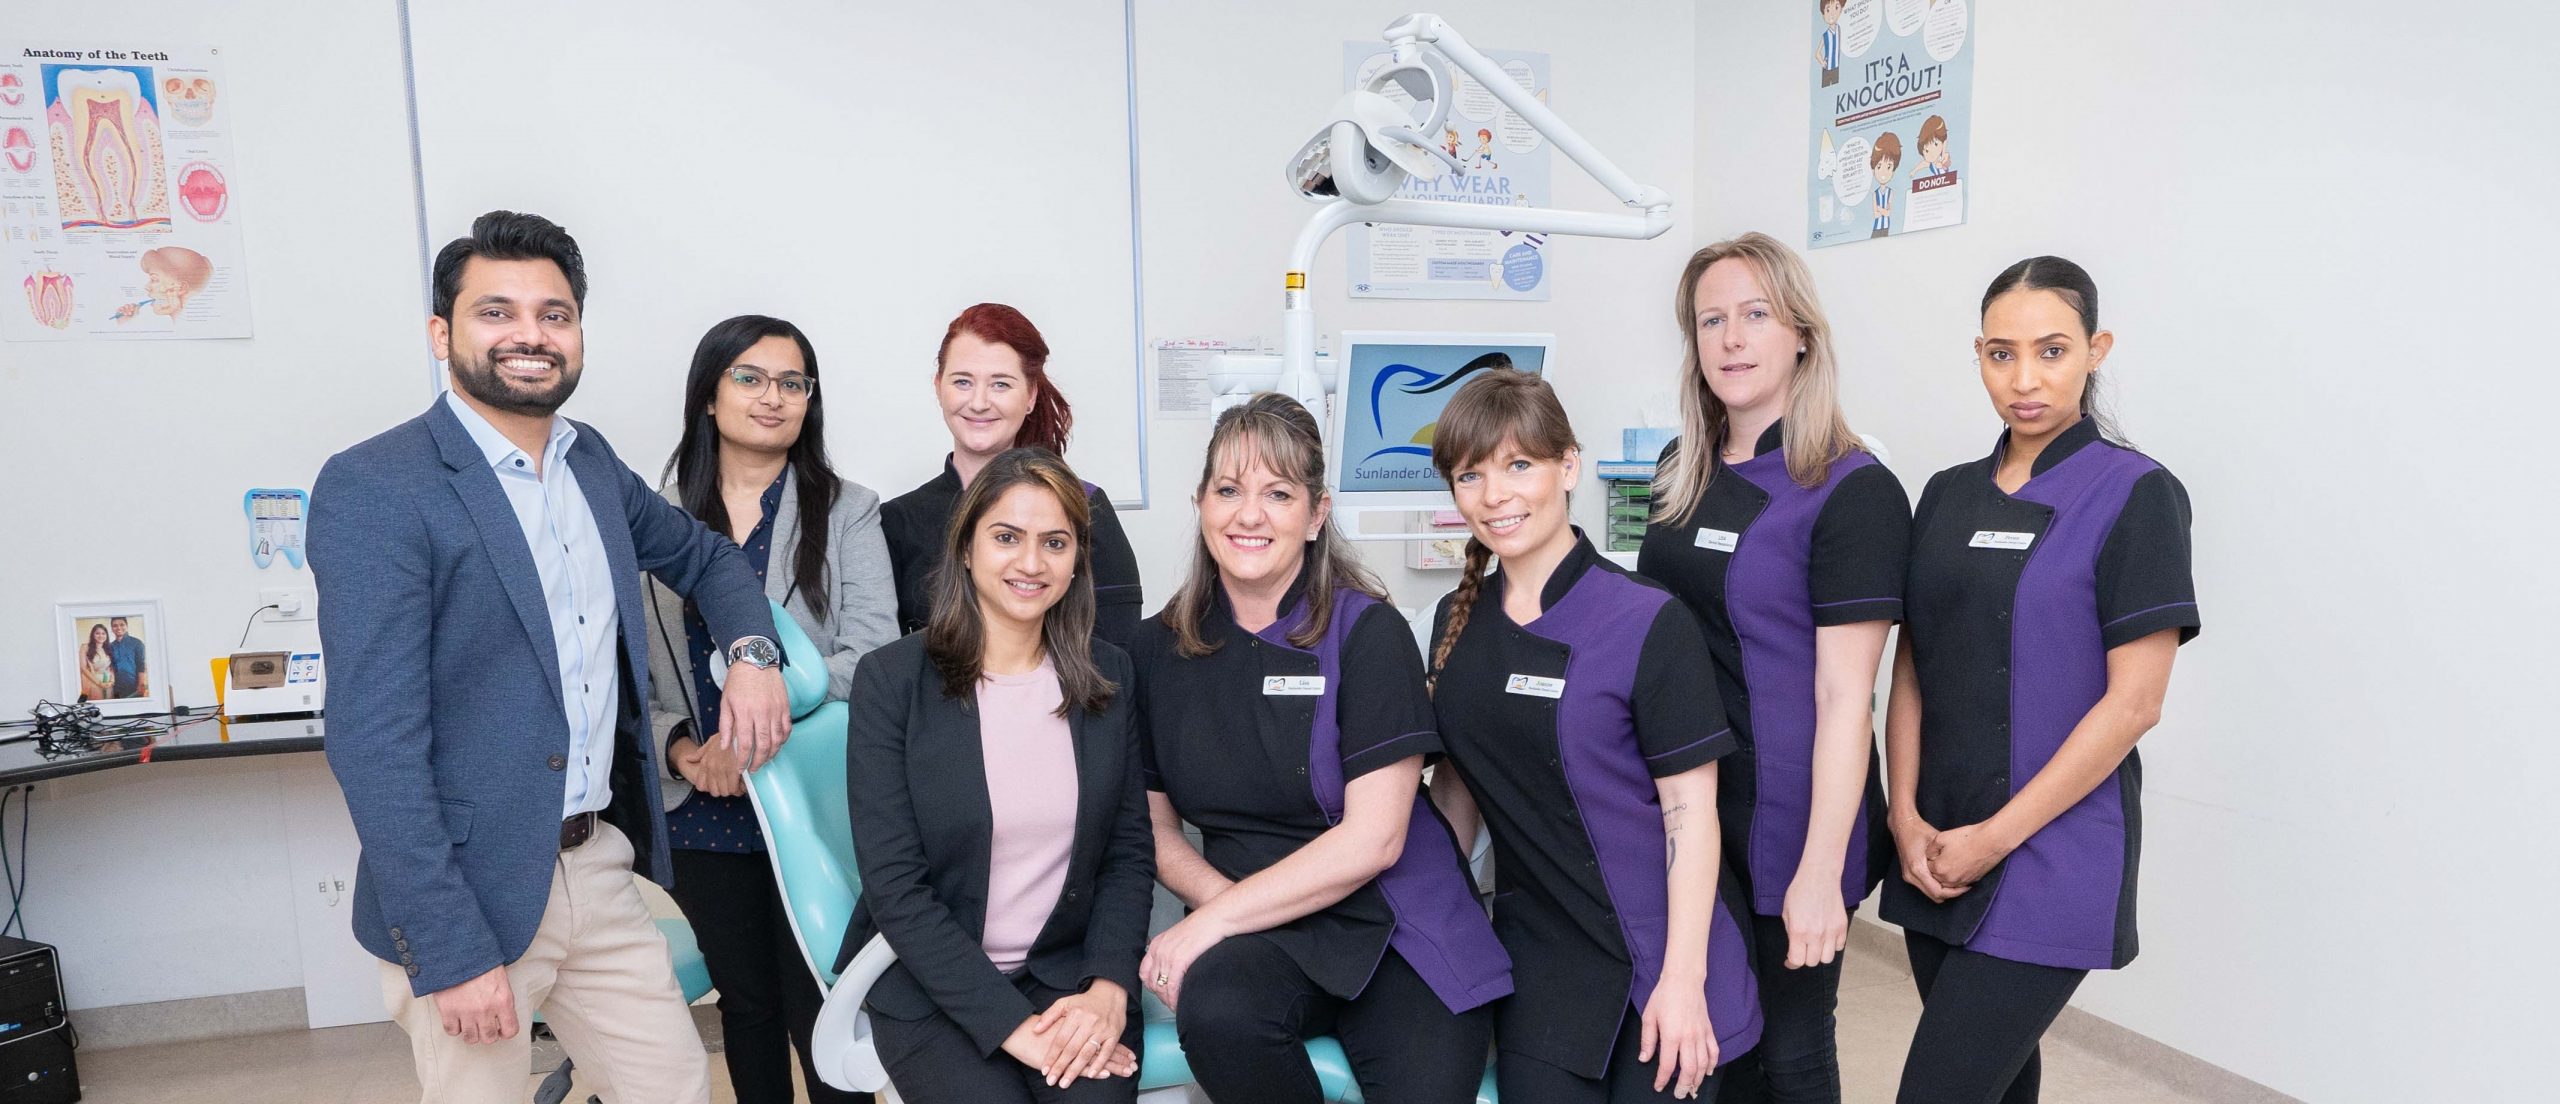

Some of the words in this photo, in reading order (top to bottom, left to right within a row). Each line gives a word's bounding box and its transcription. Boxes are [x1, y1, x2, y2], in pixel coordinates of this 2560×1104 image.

[23, 48, 83, 60] Anatomy
[88, 50, 102, 59] of
[105, 50, 127, 60] the
[131, 51, 169, 61] Teeth
[1866, 56, 1893, 83] IT'S
[1898, 52, 1910, 74] A
[1835, 64, 1942, 114] KNOCKOUT!
[1450, 175, 1511, 194] WEAR
[1919, 180, 1930, 190] DO
[1355, 467, 1420, 480] Sunlander
